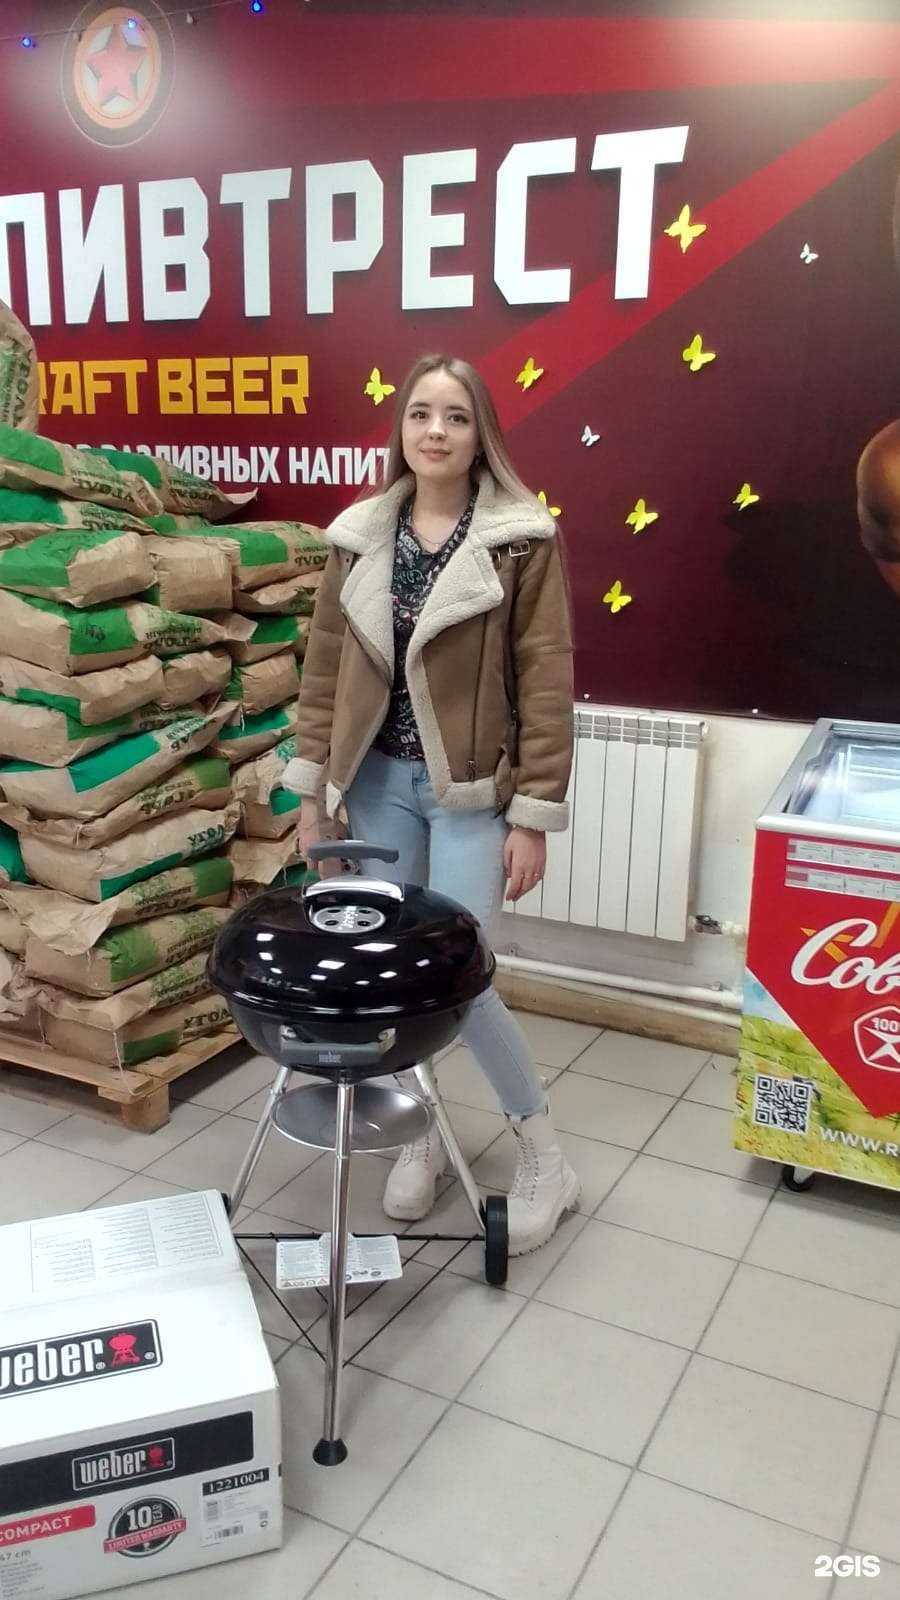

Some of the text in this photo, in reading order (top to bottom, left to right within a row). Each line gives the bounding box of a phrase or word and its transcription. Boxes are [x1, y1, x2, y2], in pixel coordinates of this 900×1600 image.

[0, 126, 689, 326] ПИВТРЕСТ
[38, 355, 309, 415] AFT BEER
[289, 446, 391, 486] НАПИТ
[79, 1449, 147, 1485] weber
[209, 1470, 265, 1493] 1221004
[127, 1505, 152, 1531] 10
